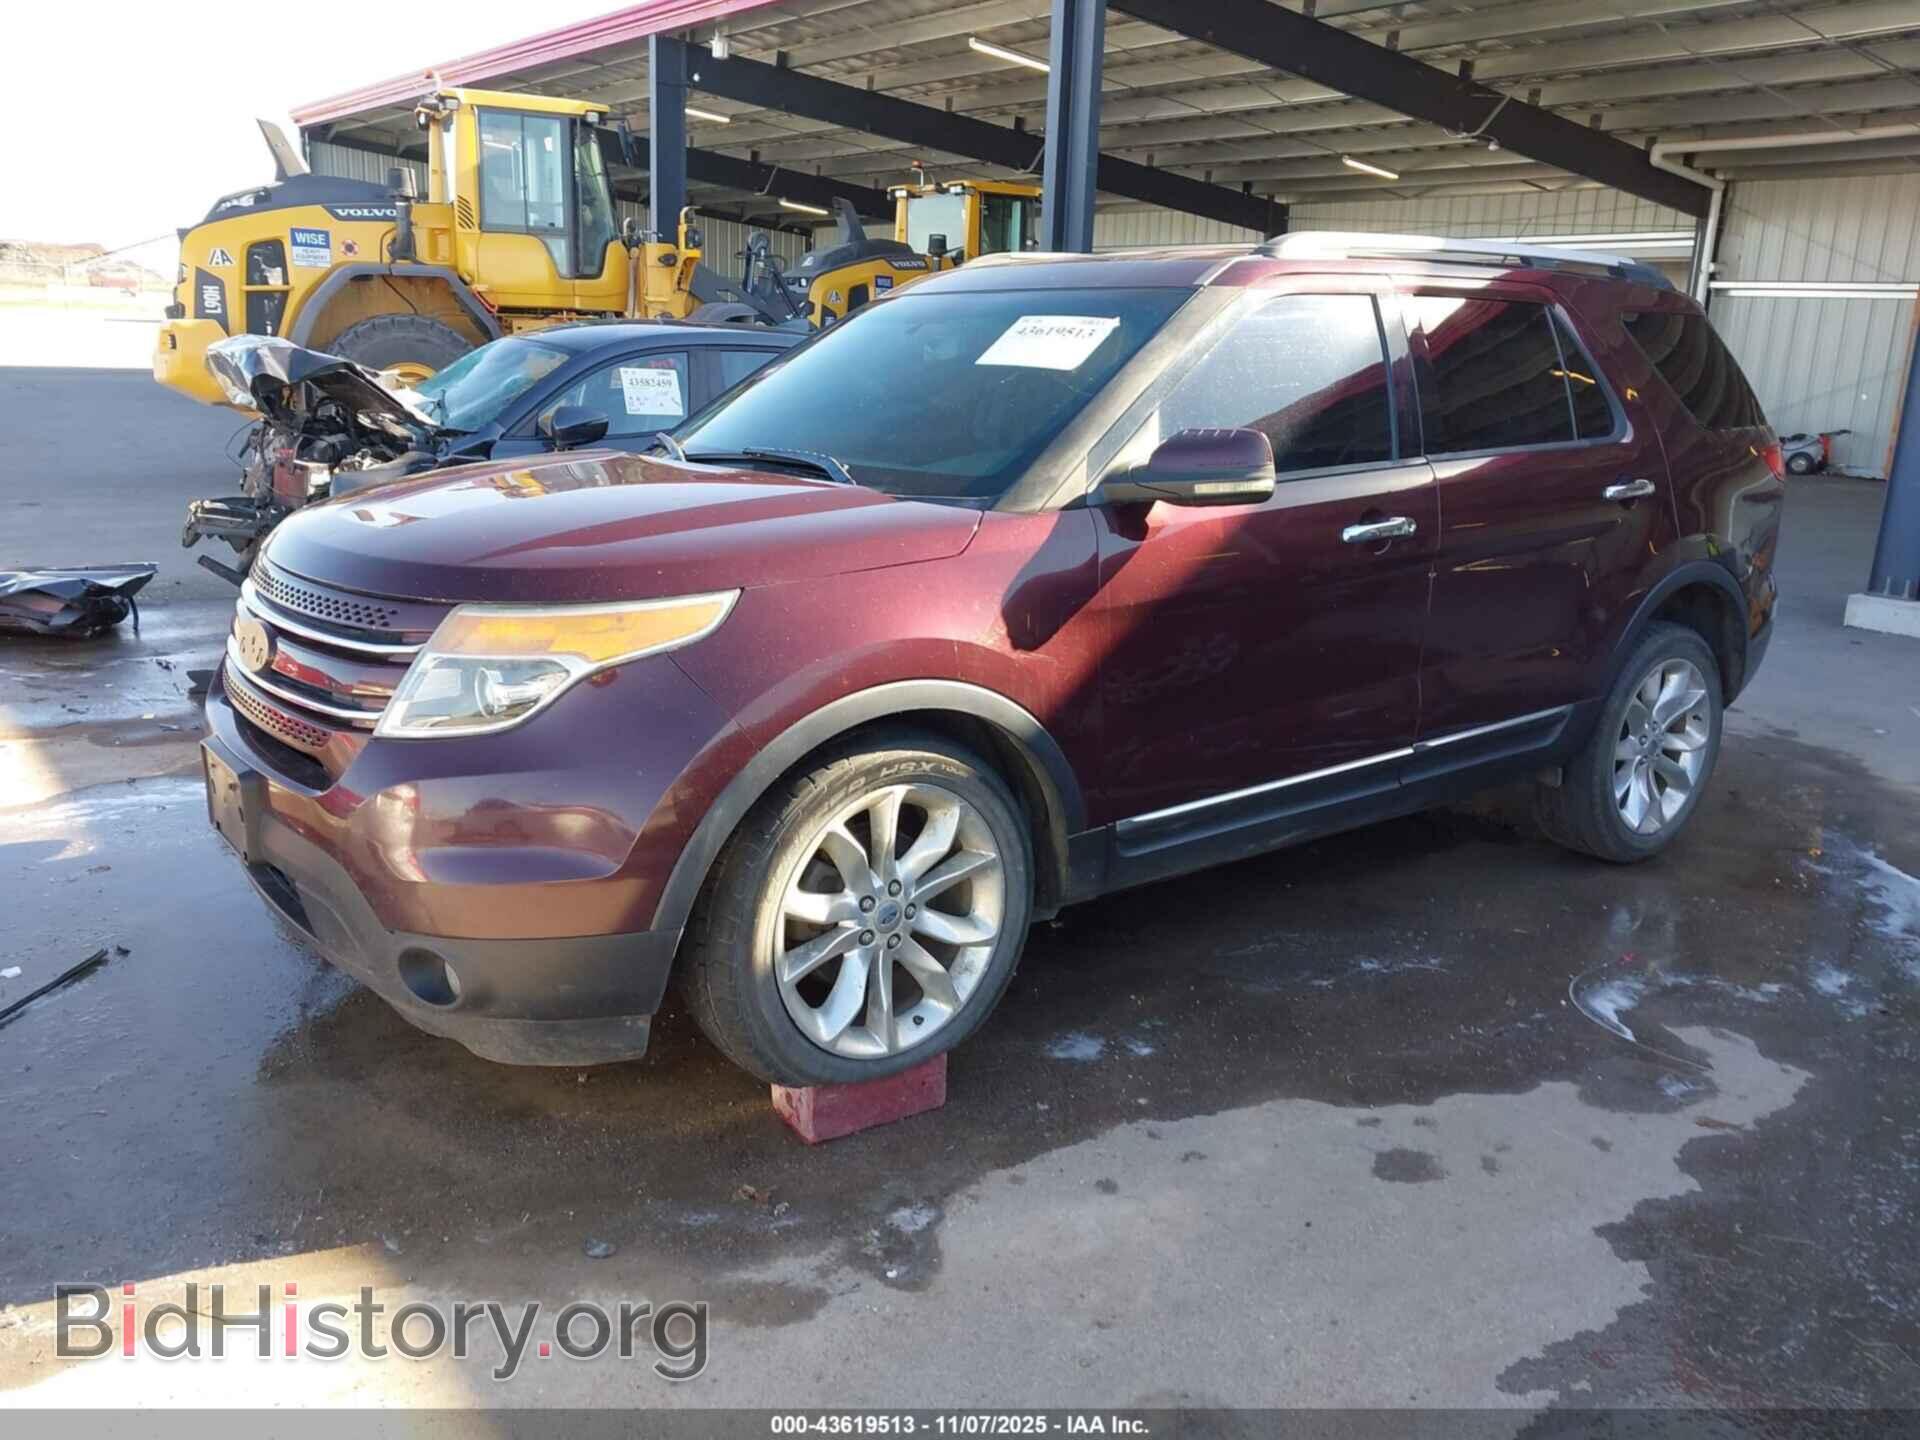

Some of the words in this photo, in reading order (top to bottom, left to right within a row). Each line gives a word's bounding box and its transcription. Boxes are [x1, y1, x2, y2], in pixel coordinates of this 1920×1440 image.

[335, 208, 398, 219] VOLVO
[294, 231, 327, 246] WISE
[202, 285, 222, 314] L90H
